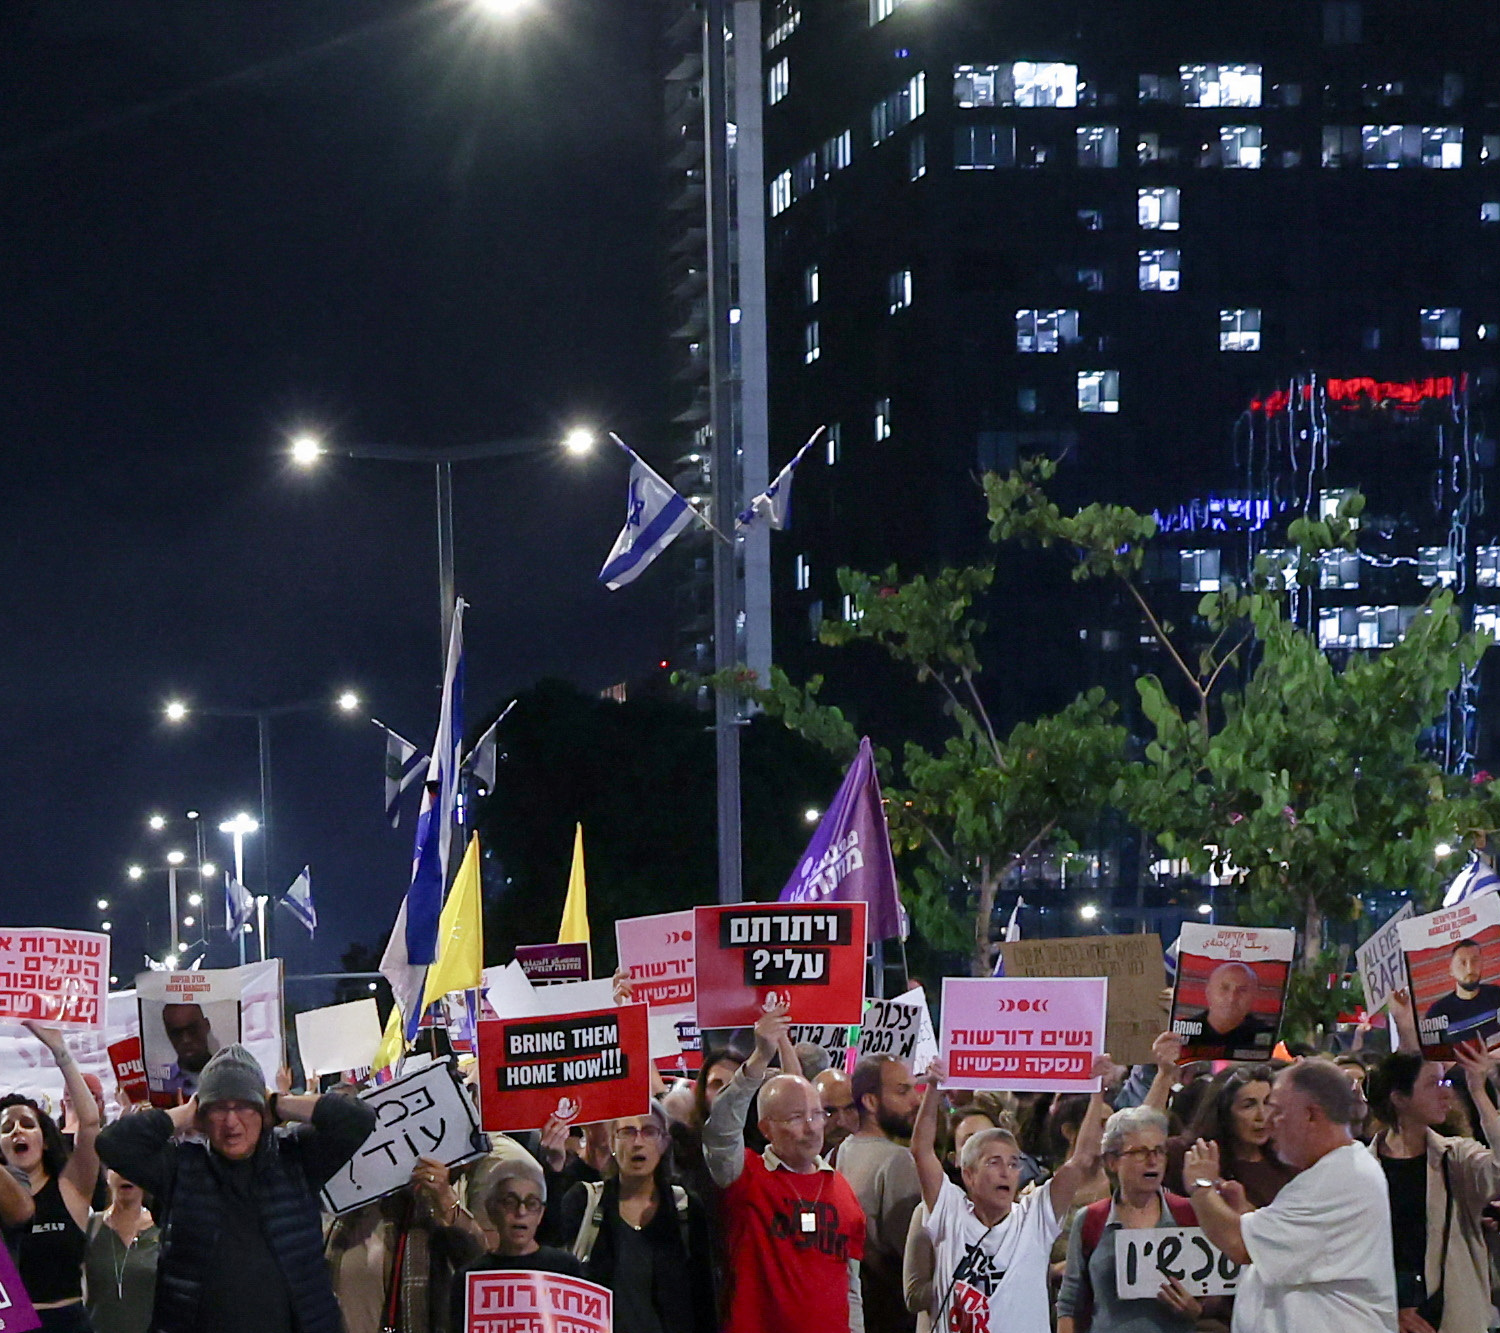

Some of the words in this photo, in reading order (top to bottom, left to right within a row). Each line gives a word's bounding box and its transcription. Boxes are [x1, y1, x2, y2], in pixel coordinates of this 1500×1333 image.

[730, 915, 838, 943] ויתרתם
[20, 937, 101, 958] עוצרות
[752, 949, 824, 981] עלי?
[509, 1032, 566, 1056] BRING
[571, 1024, 619, 1049] THEM
[951, 1029, 1034, 1046] דורשות
[1041, 1030, 1093, 1047] נשים
[506, 1065, 557, 1087] HOME
[563, 1047, 623, 1082] NOW!!!
[956, 1056, 1020, 1072] עכשיו!
[1025, 1056, 1084, 1074] עסקה
[482, 1285, 602, 1321] מחזרות
